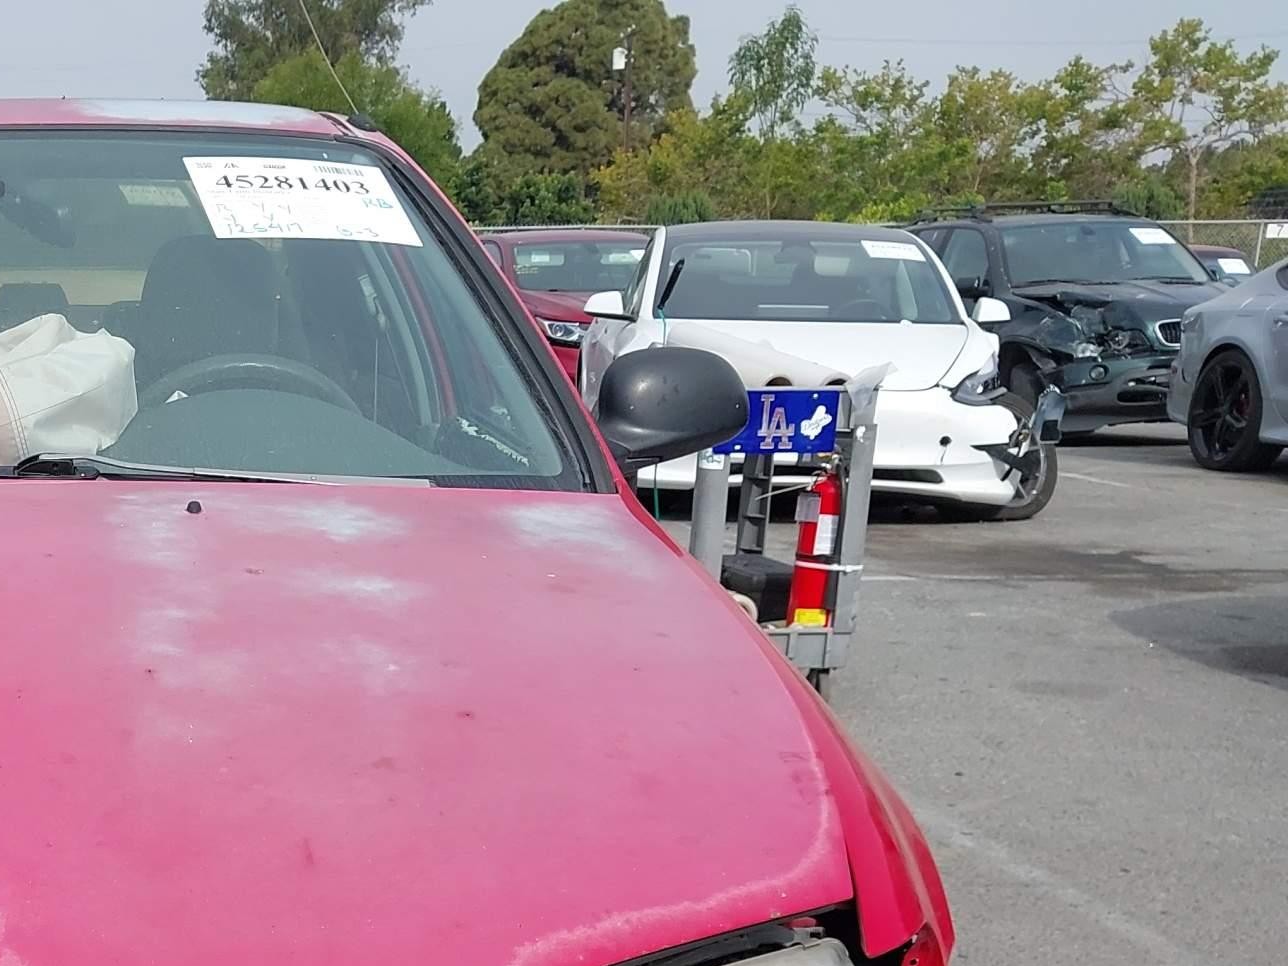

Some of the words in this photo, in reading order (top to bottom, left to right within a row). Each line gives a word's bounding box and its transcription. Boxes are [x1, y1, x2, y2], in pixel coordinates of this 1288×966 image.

[215, 174, 370, 195] 45281403
[1277, 224, 1285, 237] 7
[757, 393, 795, 449] LA
